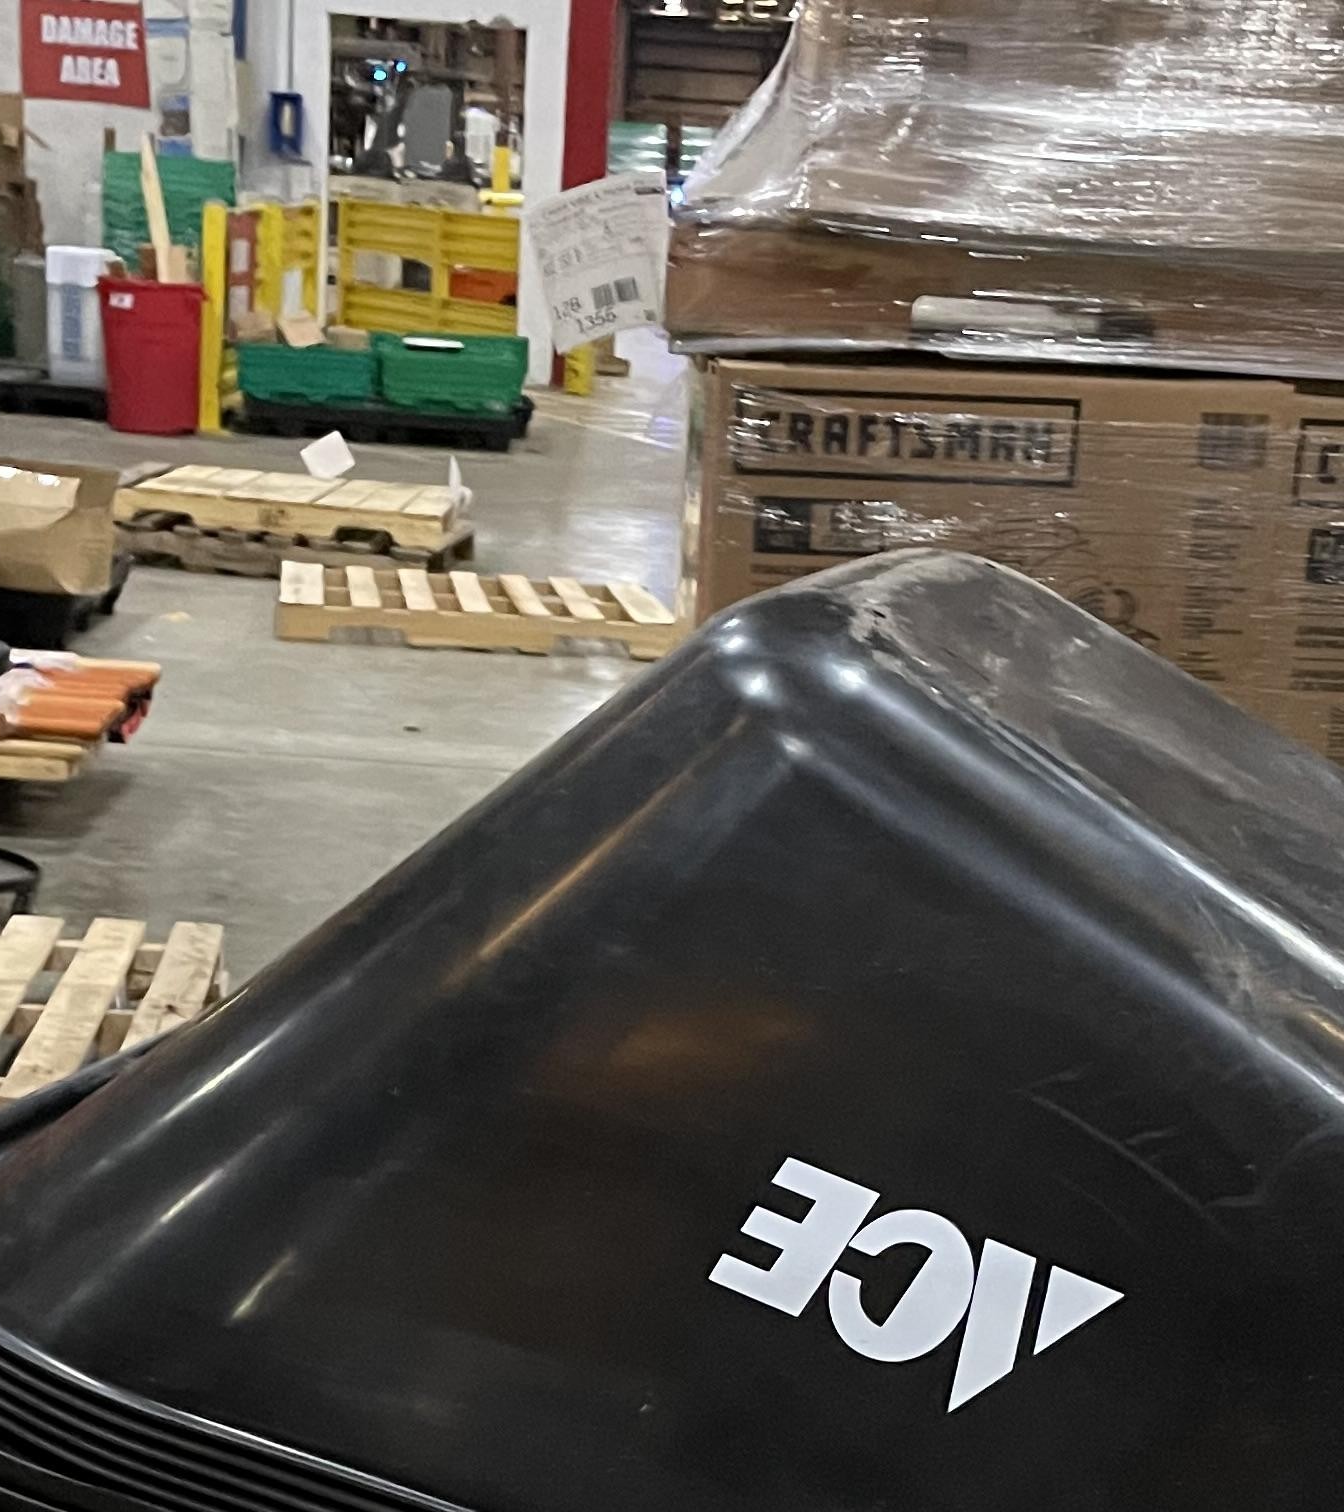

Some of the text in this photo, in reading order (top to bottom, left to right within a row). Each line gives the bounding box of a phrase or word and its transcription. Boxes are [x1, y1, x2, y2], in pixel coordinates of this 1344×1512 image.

[40, 14, 139, 50] DAMAGE
[59, 54, 121, 88] AREA
[708, 1156, 1125, 1413] ACE
